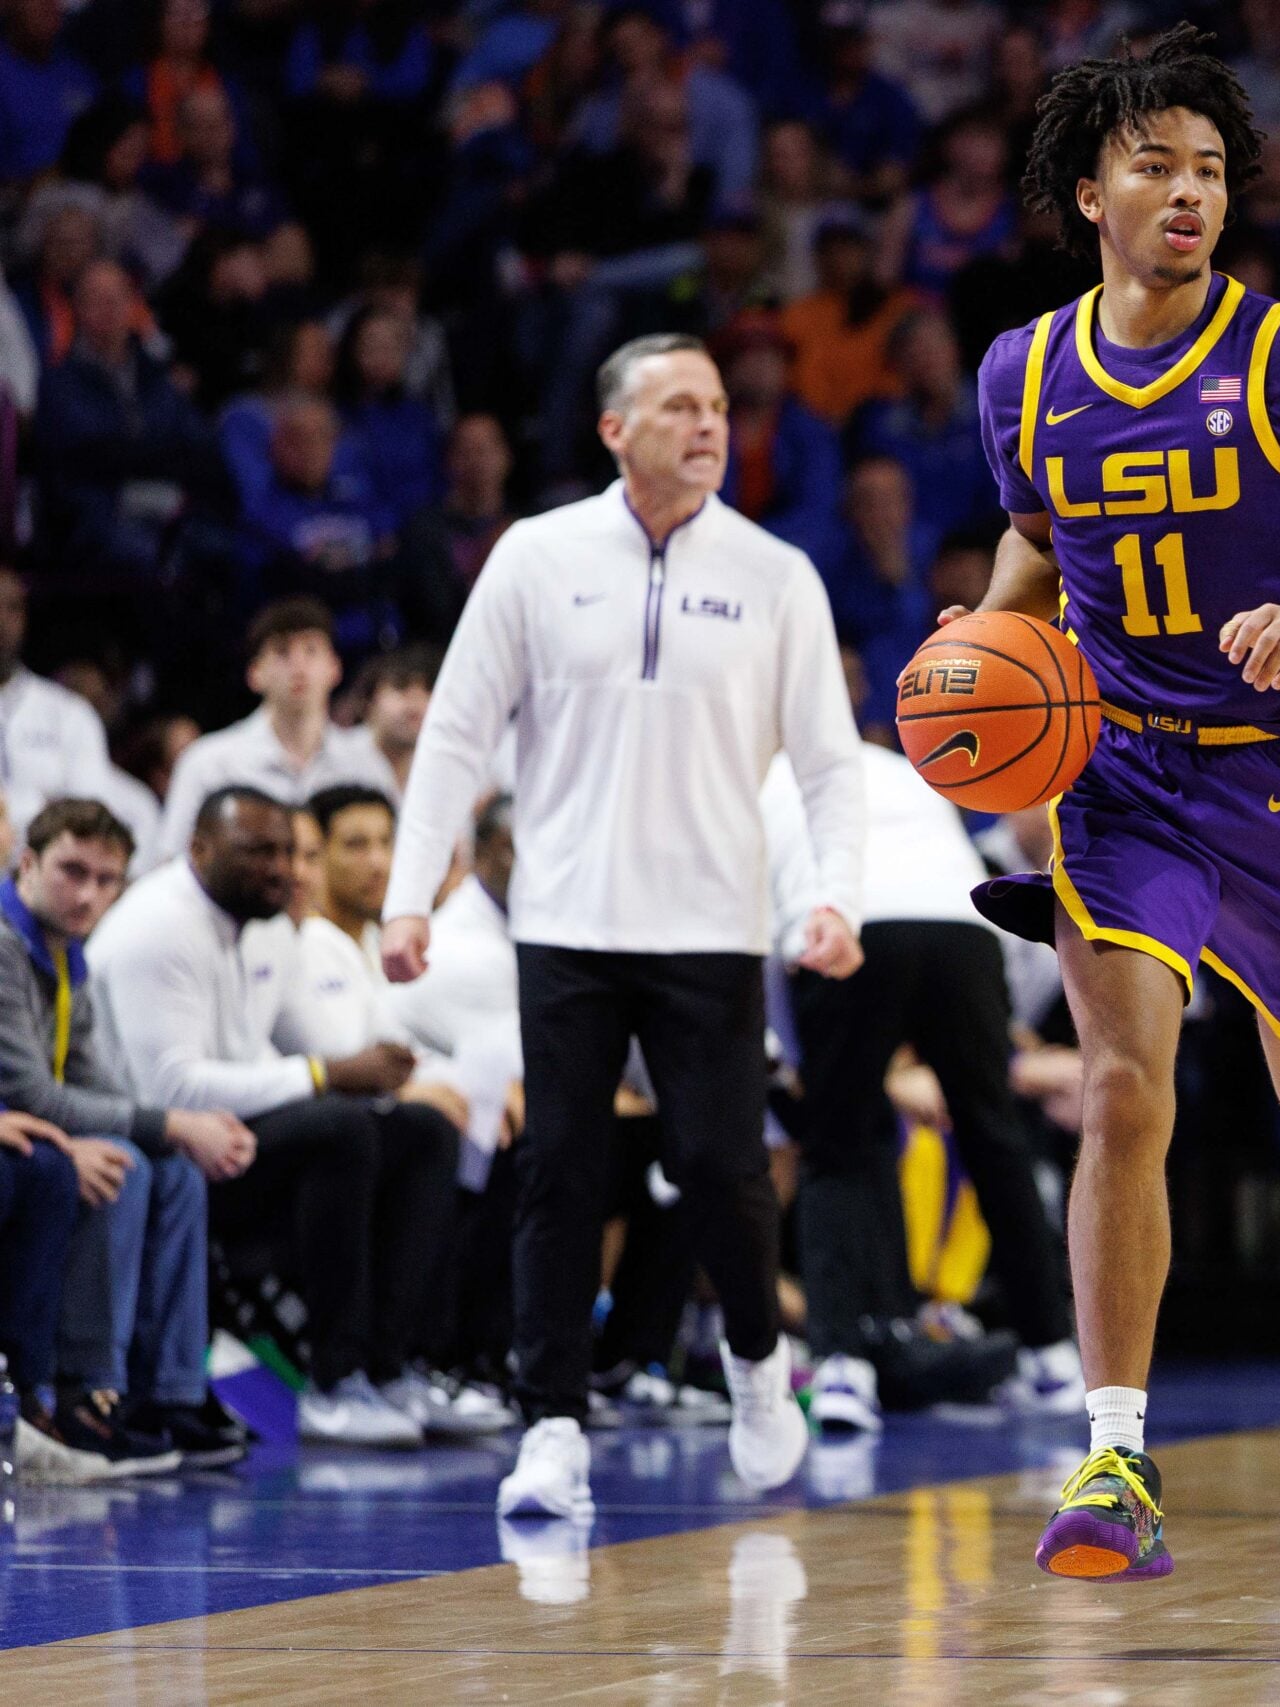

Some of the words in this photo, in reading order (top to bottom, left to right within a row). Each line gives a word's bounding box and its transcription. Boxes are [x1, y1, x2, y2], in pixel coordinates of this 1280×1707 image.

[1209, 411, 1230, 433] SEC
[1045, 447, 1241, 518] LSU
[1114, 533, 1203, 636] 11
[681, 594, 741, 621] LSU
[901, 667, 980, 700] ELITE
[1147, 713, 1192, 734] LSU
